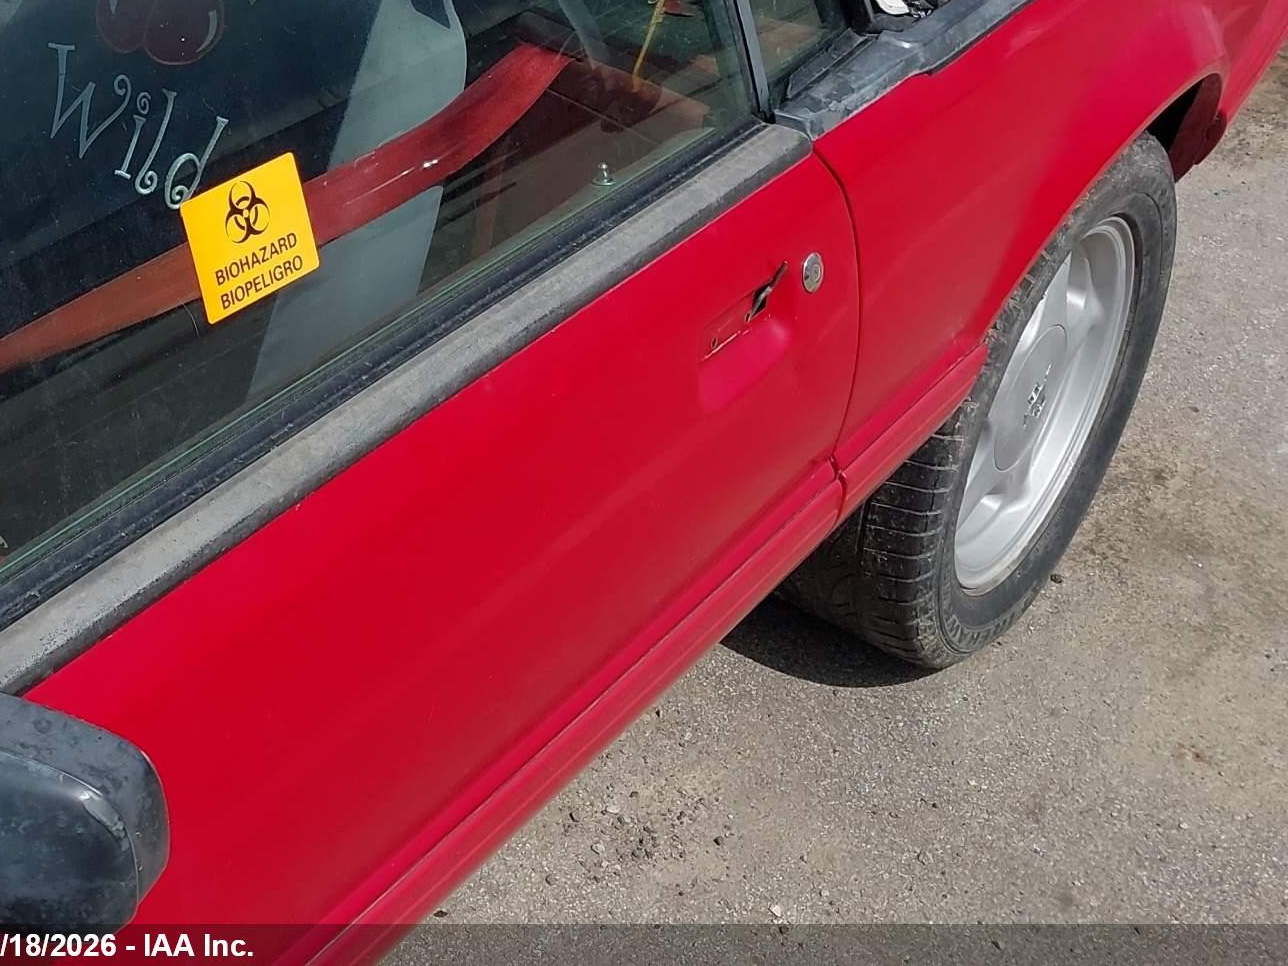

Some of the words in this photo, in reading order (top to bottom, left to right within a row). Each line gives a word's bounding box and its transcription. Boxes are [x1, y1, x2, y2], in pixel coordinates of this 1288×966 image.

[48, 42, 229, 210] Wild
[215, 232, 298, 286] BIOHAZARD
[220, 255, 303, 310] BIOPELIGRO
